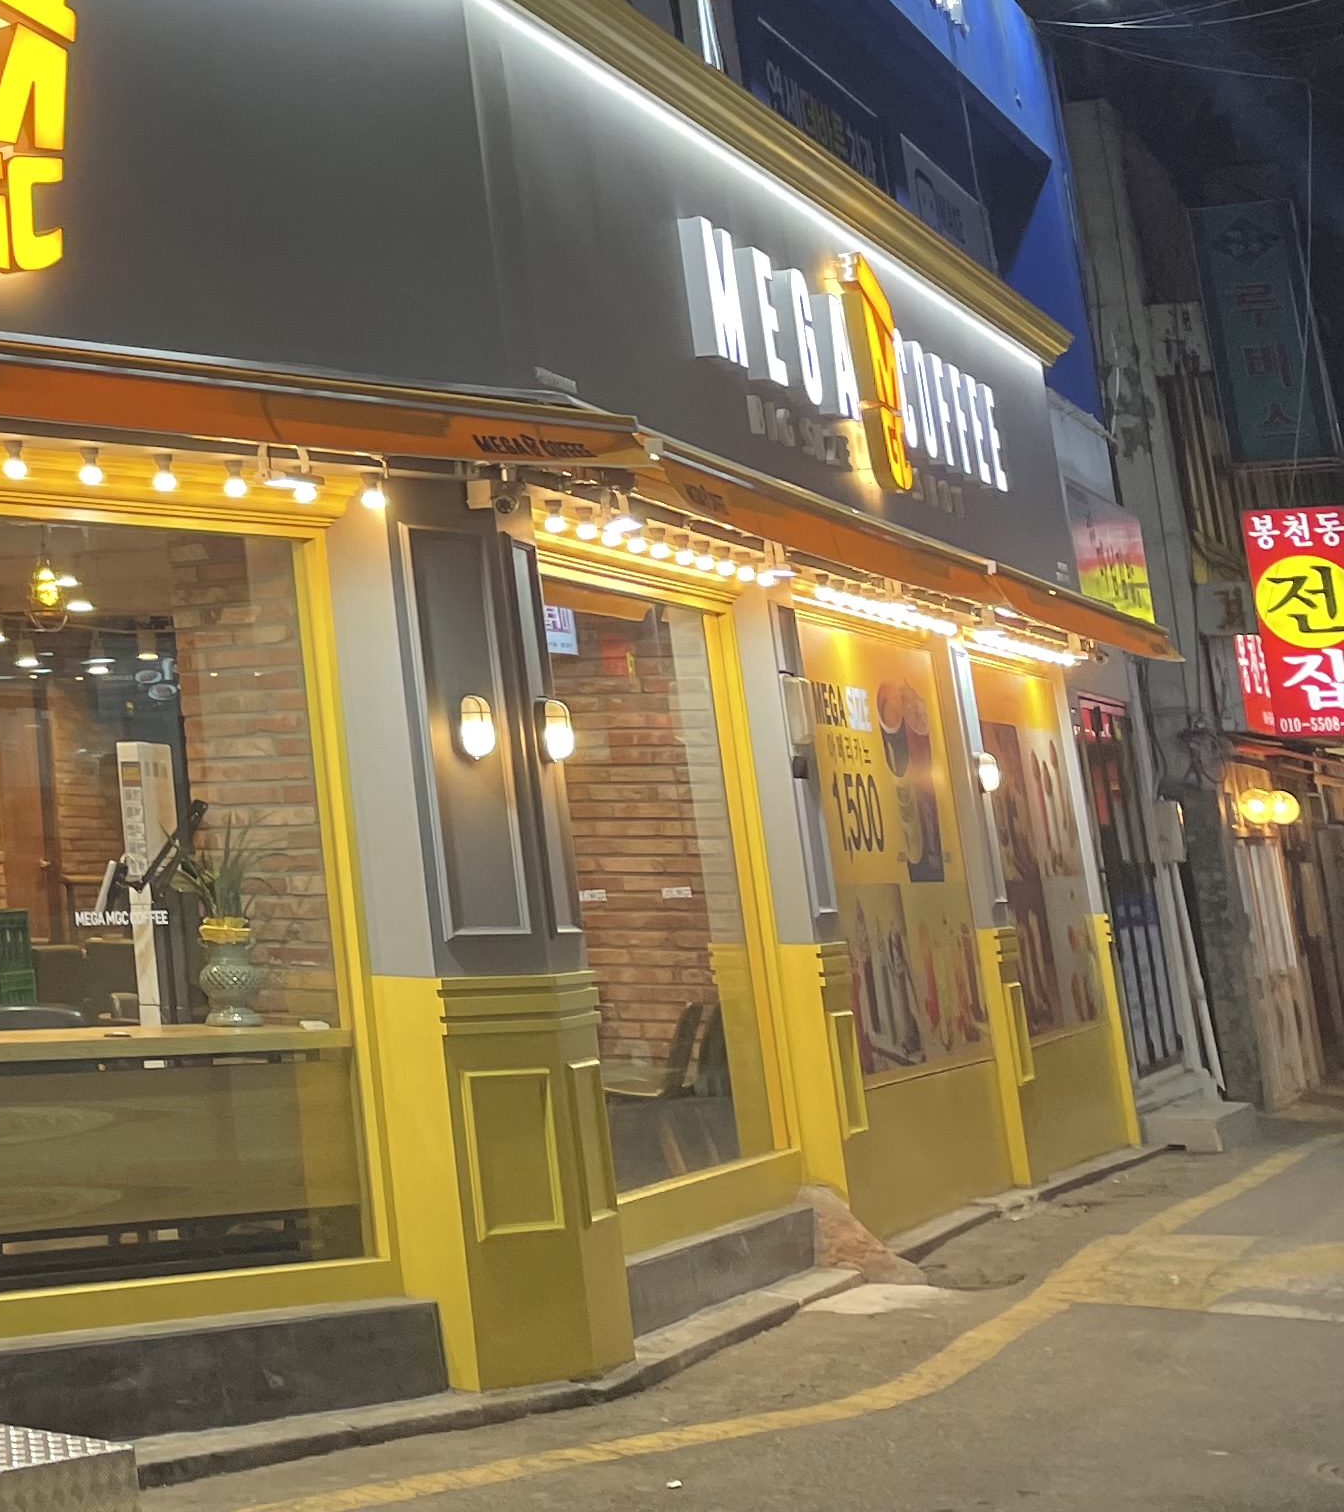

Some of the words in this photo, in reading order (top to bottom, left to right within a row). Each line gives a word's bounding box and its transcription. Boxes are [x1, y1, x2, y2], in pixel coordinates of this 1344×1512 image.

[678, 216, 862, 421] MEGA
[894, 327, 1010, 493] COFFEE
[1248, 512, 1344, 550] 봉천동
[810, 680, 848, 728] MEGA
[832, 770, 885, 864] 1,500
[74, 911, 106, 927] MEGA
[106, 910, 129, 926] MGC
[130, 909, 169, 925] COFFEE
